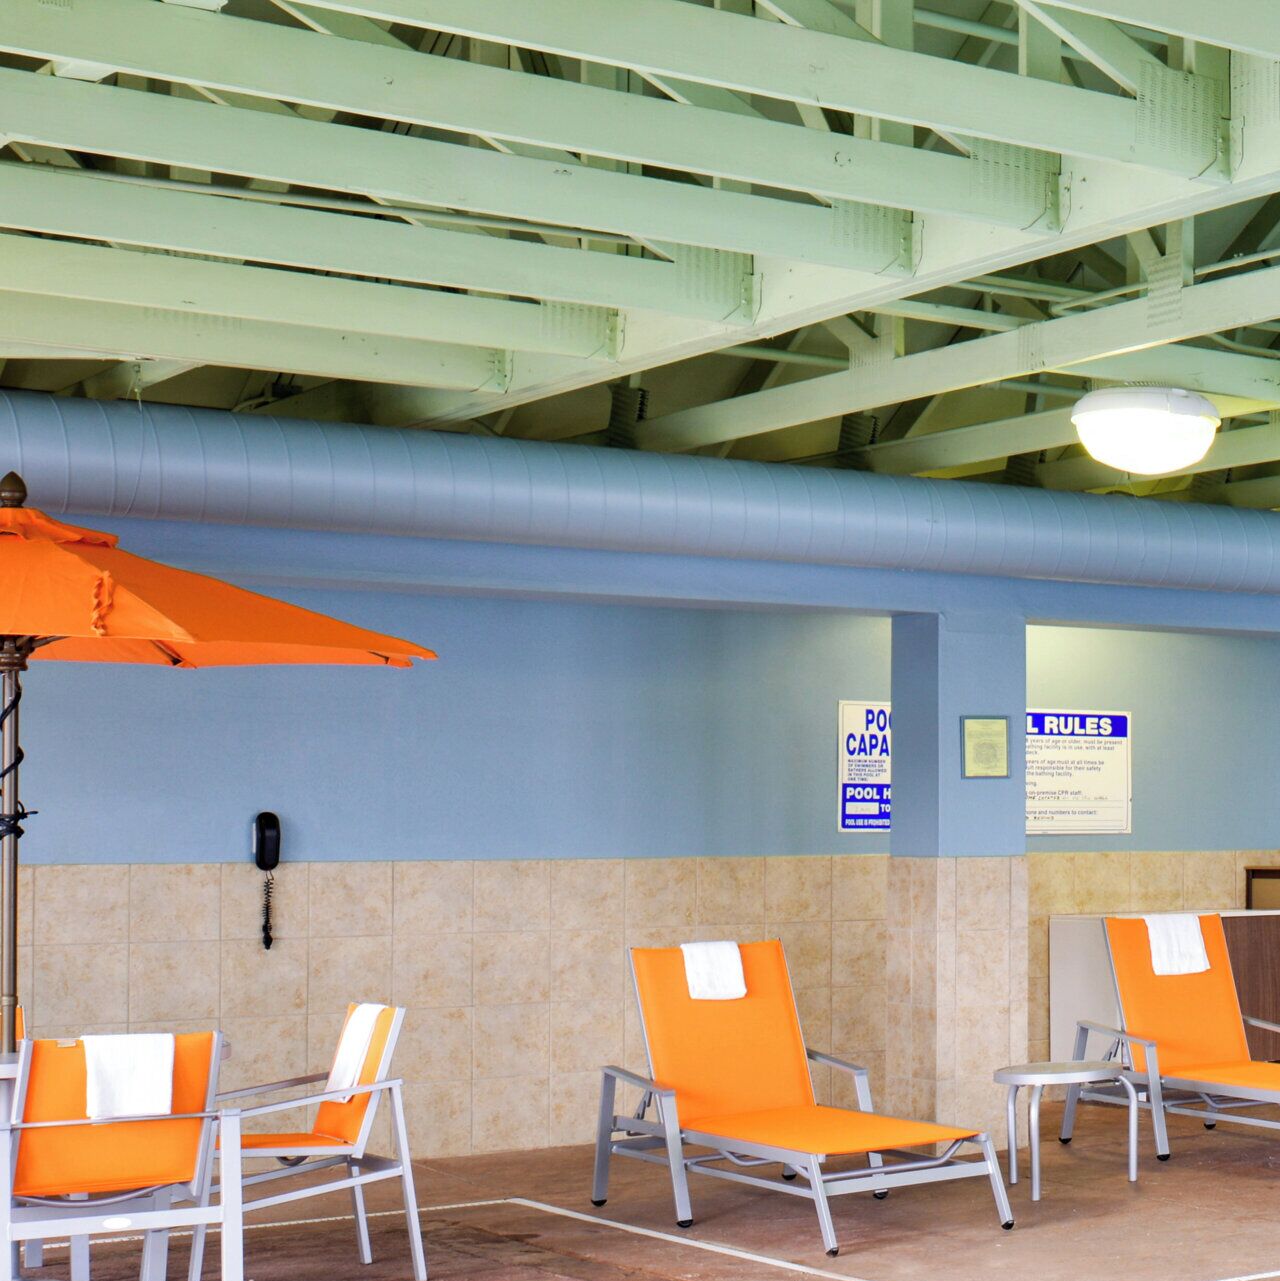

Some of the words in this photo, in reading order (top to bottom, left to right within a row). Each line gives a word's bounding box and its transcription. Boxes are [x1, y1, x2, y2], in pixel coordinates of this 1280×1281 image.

[865, 708, 891, 732] PO
[1044, 715, 1113, 736] RULES
[846, 787, 881, 800] POOL
